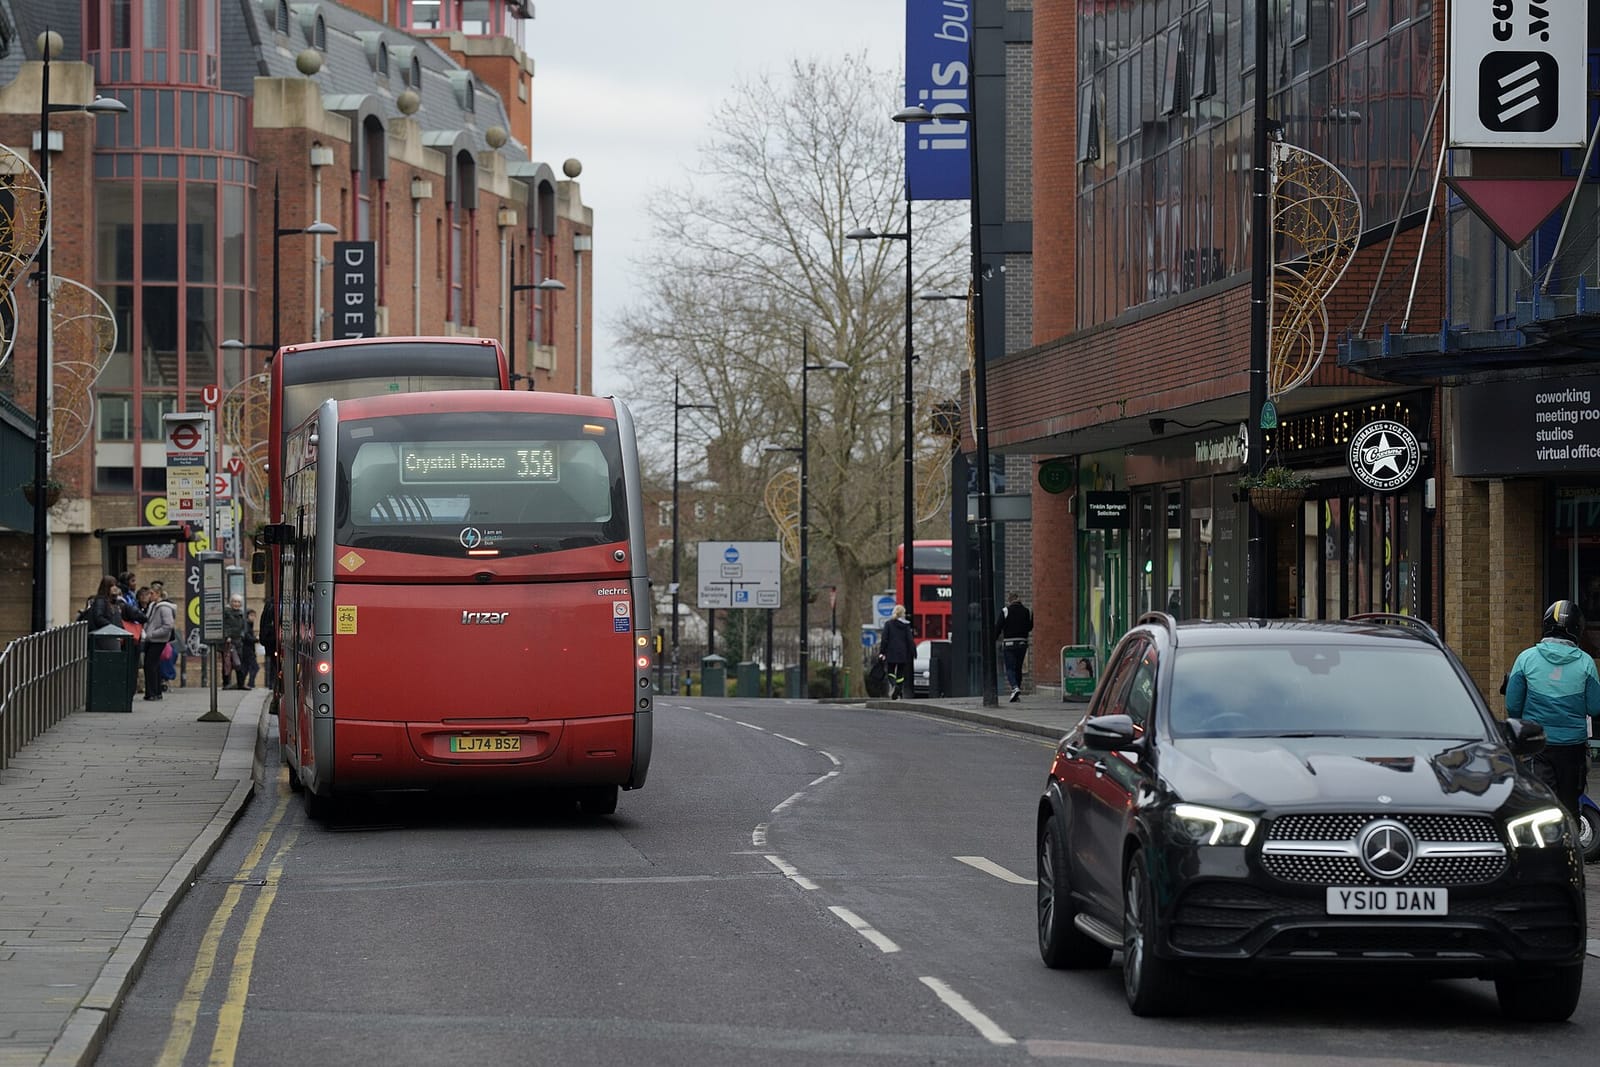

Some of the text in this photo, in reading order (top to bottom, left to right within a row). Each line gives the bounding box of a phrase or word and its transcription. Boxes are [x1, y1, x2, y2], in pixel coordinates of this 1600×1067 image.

[919, 0, 969, 150] ibis bu
[203, 388, 218, 404] U
[1535, 388, 1591, 404] coworking
[1536, 407, 1579, 424] meeting
[1389, 424, 1403, 435] ICE
[1402, 432, 1417, 459] CREAM
[1536, 426, 1574, 441] studios
[1353, 424, 1383, 462] MILKSHAKES
[1536, 444, 1570, 460] virtual
[229, 460, 240, 471] V
[405, 450, 554, 477] Crystal Palace 358
[1357, 467, 1383, 487] CREPES
[1389, 465, 1414, 487] COFFEE
[152, 504, 167, 520] G
[597, 587, 628, 596] electric
[461, 610, 509, 625] Irizar
[458, 738, 520, 750] LJ74 BSZ
[1396, 890, 1435, 910] DAN
